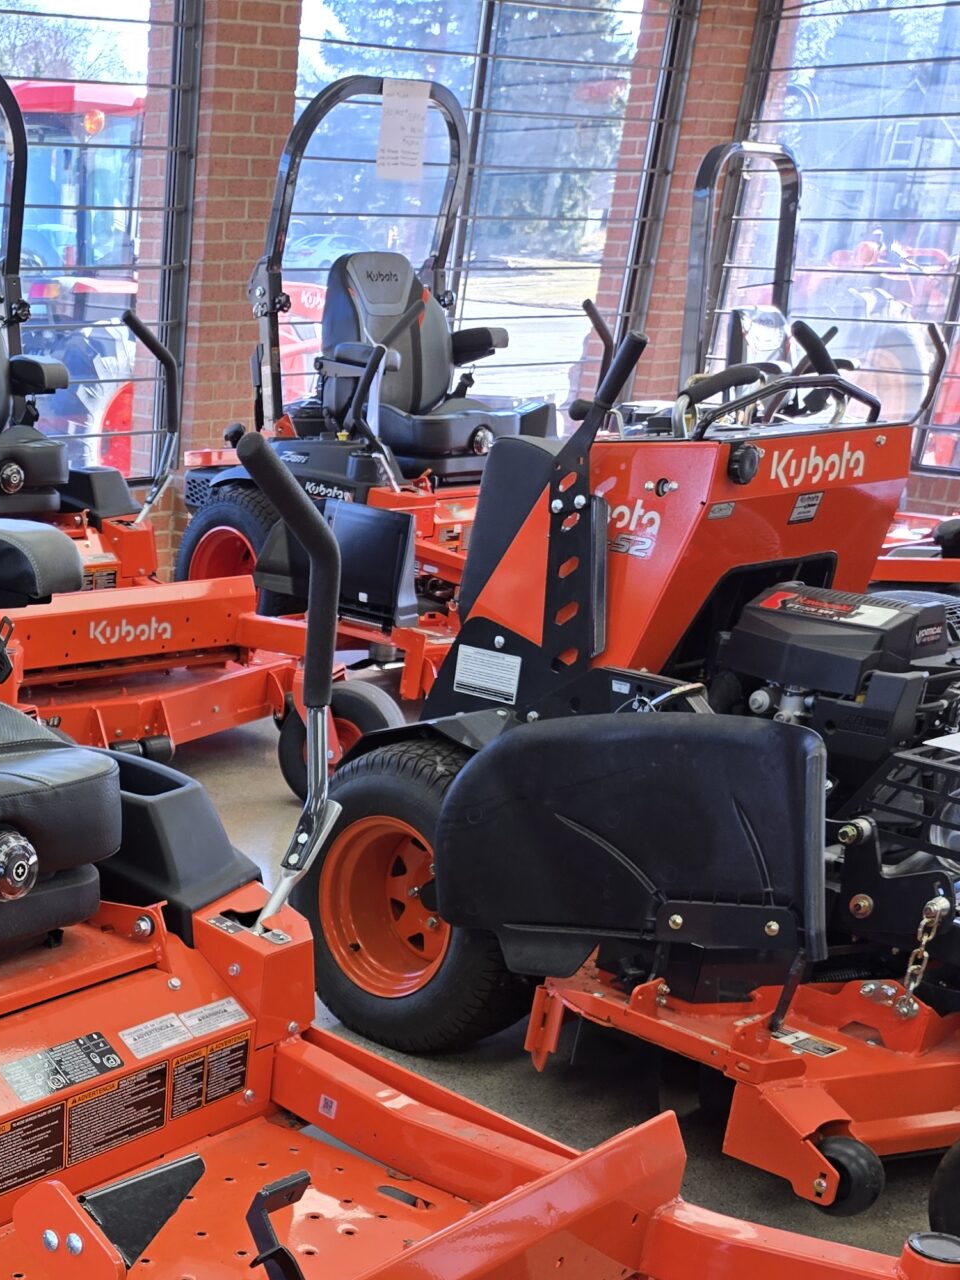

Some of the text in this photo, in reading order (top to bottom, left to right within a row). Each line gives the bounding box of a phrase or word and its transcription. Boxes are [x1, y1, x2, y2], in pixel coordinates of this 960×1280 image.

[366, 270, 399, 282] Kubota
[770, 441, 865, 488] Kubota
[305, 481, 344, 499] Kubota
[608, 499, 661, 536] ota
[89, 616, 171, 644] Kubota
[78, 1082, 115, 1102] ADVERTENCIA
